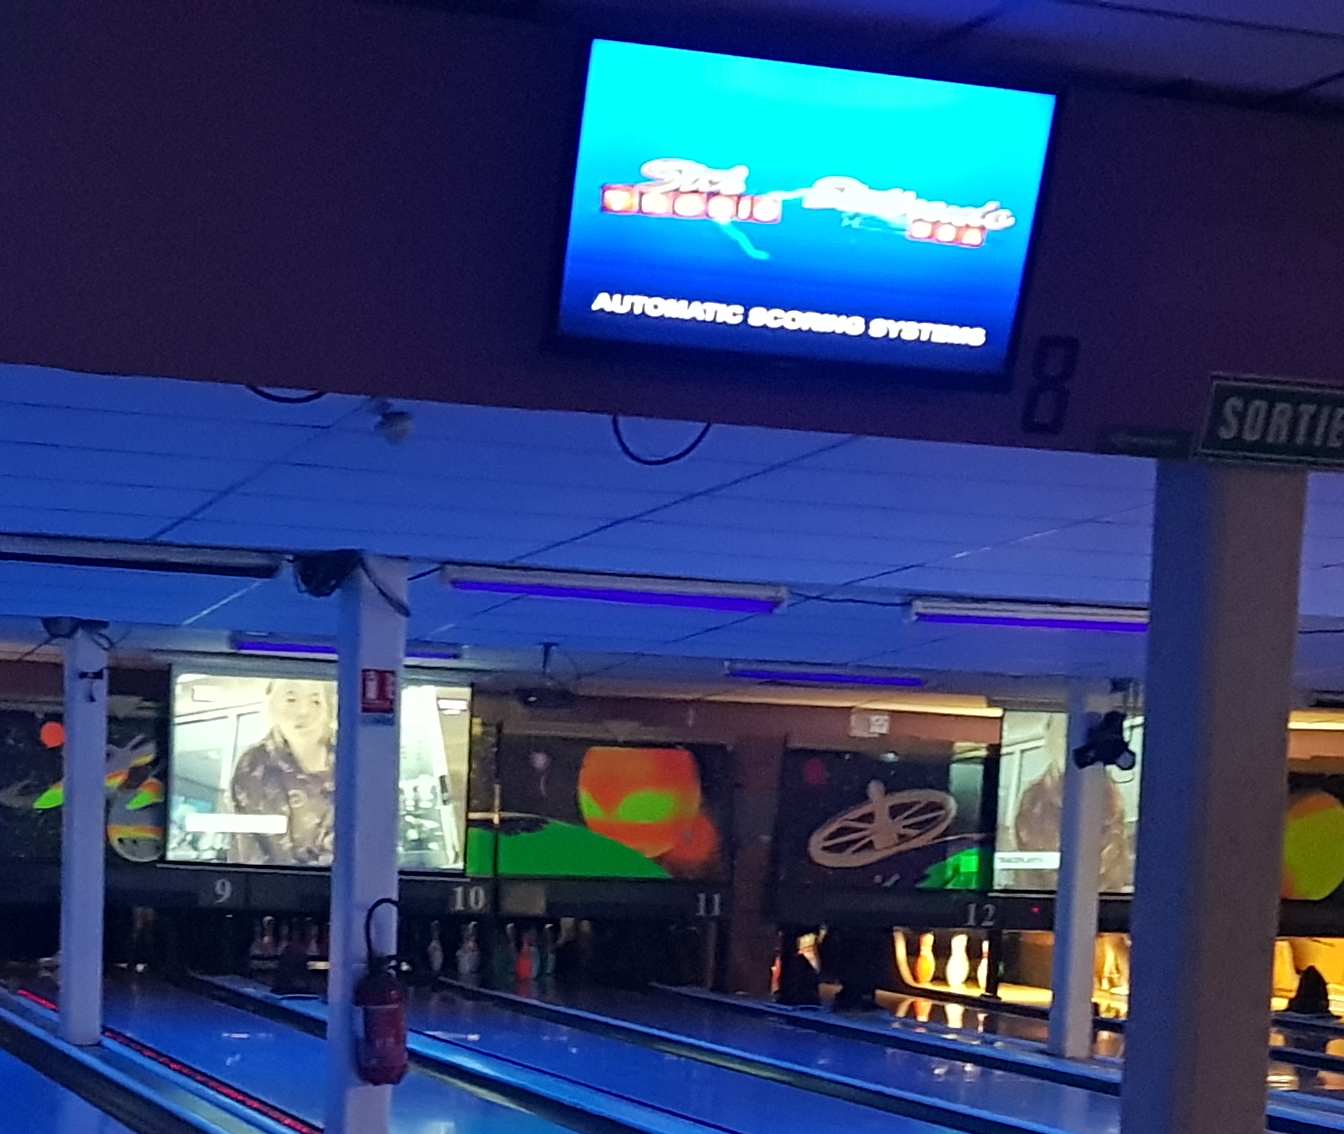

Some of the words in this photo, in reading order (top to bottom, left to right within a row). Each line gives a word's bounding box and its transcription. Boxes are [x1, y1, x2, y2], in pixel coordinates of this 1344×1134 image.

[591, 292, 744, 325] AUTOMATIC
[748, 307, 865, 336] SCORING
[868, 318, 986, 346] SYSTEMS
[1022, 335, 1078, 433] 8
[214, 878, 232, 904] 9
[453, 885, 485, 911] 10
[695, 892, 721, 917] 11
[964, 903, 997, 927] 12
